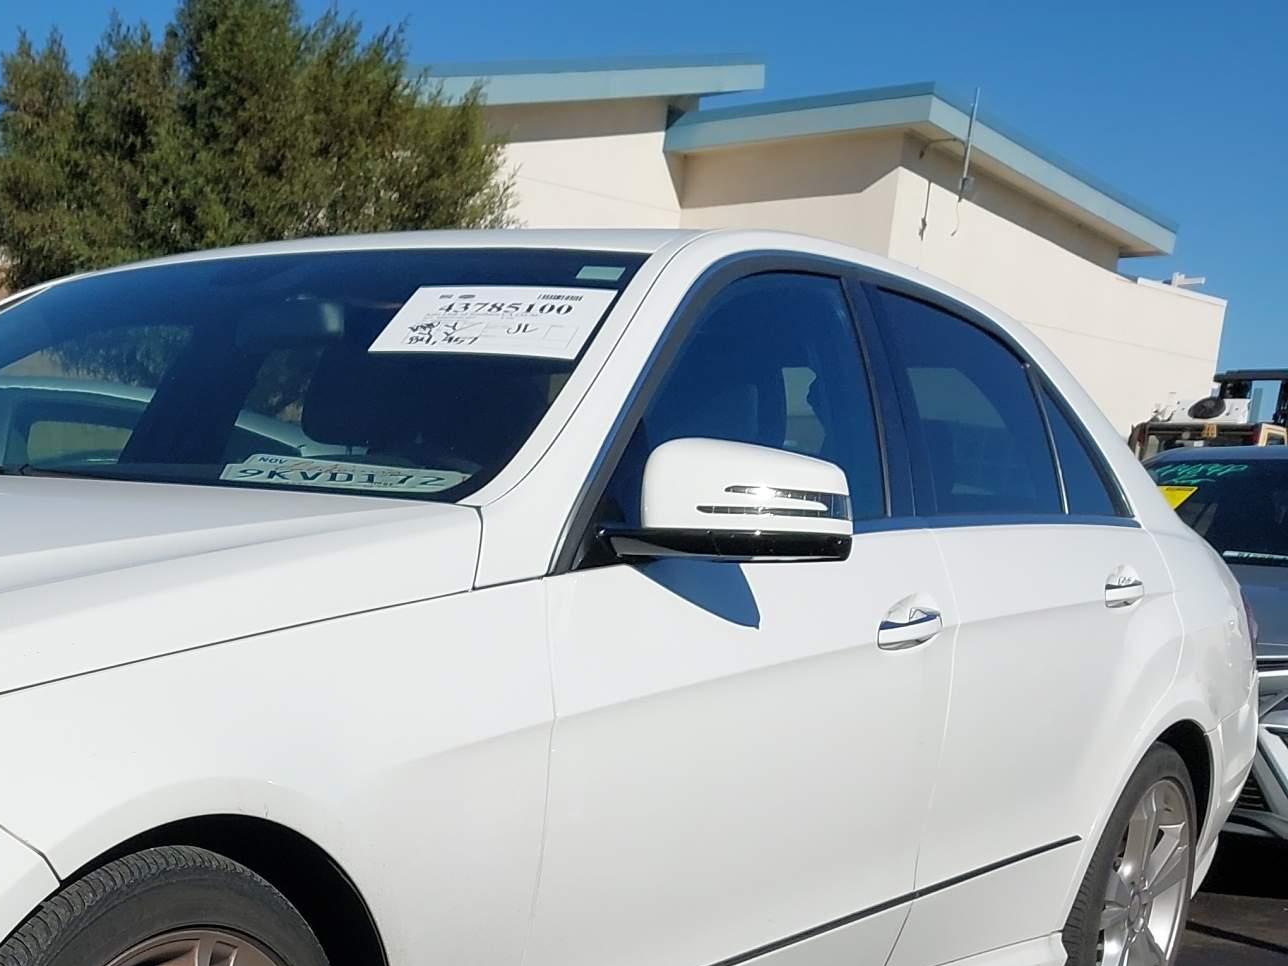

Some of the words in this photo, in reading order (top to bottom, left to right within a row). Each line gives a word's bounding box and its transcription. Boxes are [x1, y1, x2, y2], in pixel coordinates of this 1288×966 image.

[439, 302, 573, 315] 43785100
[258, 456, 287, 465] NOV
[239, 468, 446, 488] 9KVD172
